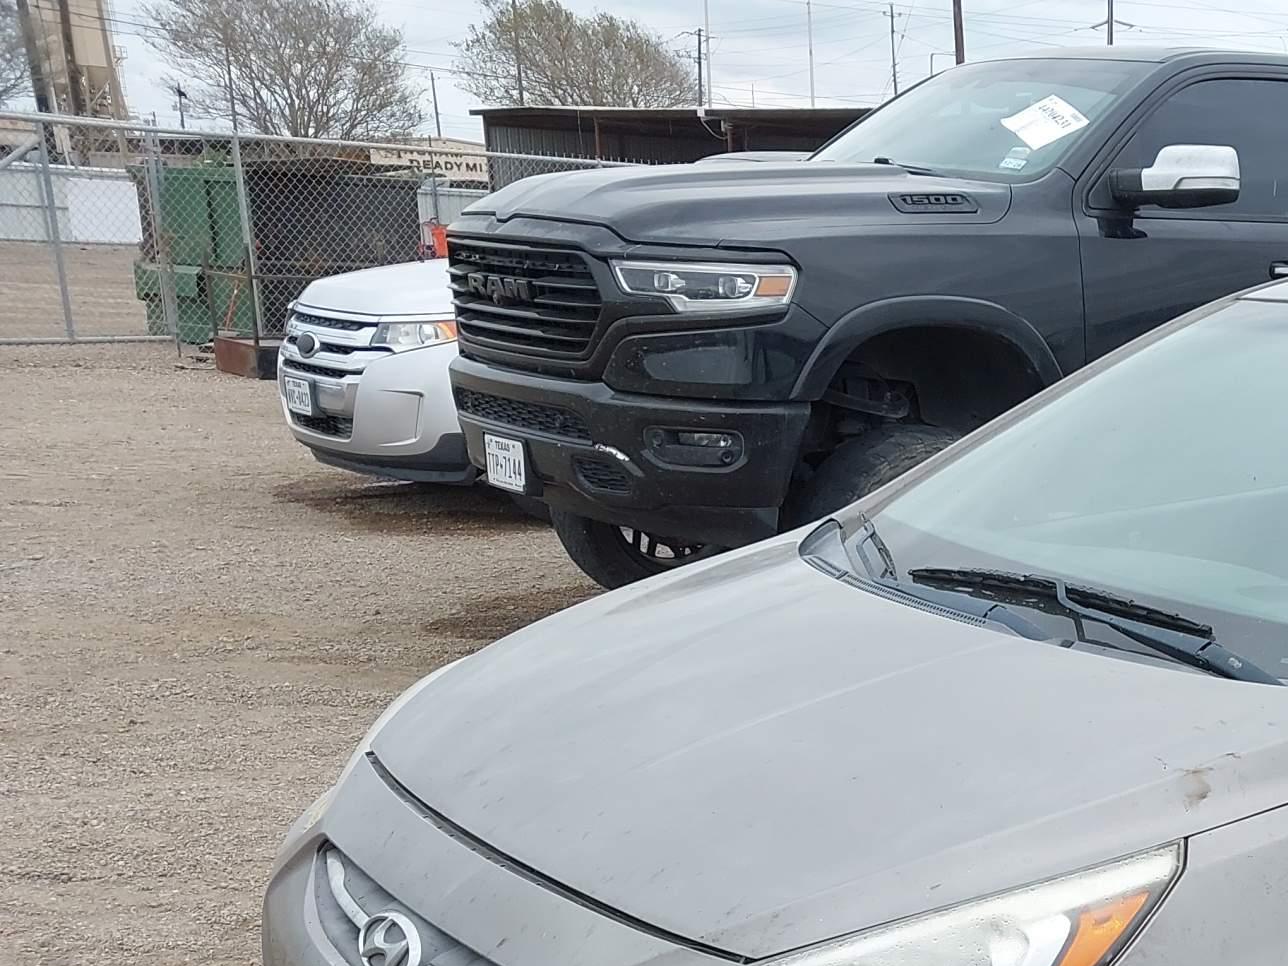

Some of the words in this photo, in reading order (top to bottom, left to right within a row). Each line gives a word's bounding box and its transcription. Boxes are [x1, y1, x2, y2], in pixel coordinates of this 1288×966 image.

[900, 193, 964, 206] 1500
[467, 272, 530, 299] RAM
[495, 440, 510, 452] TEXAS
